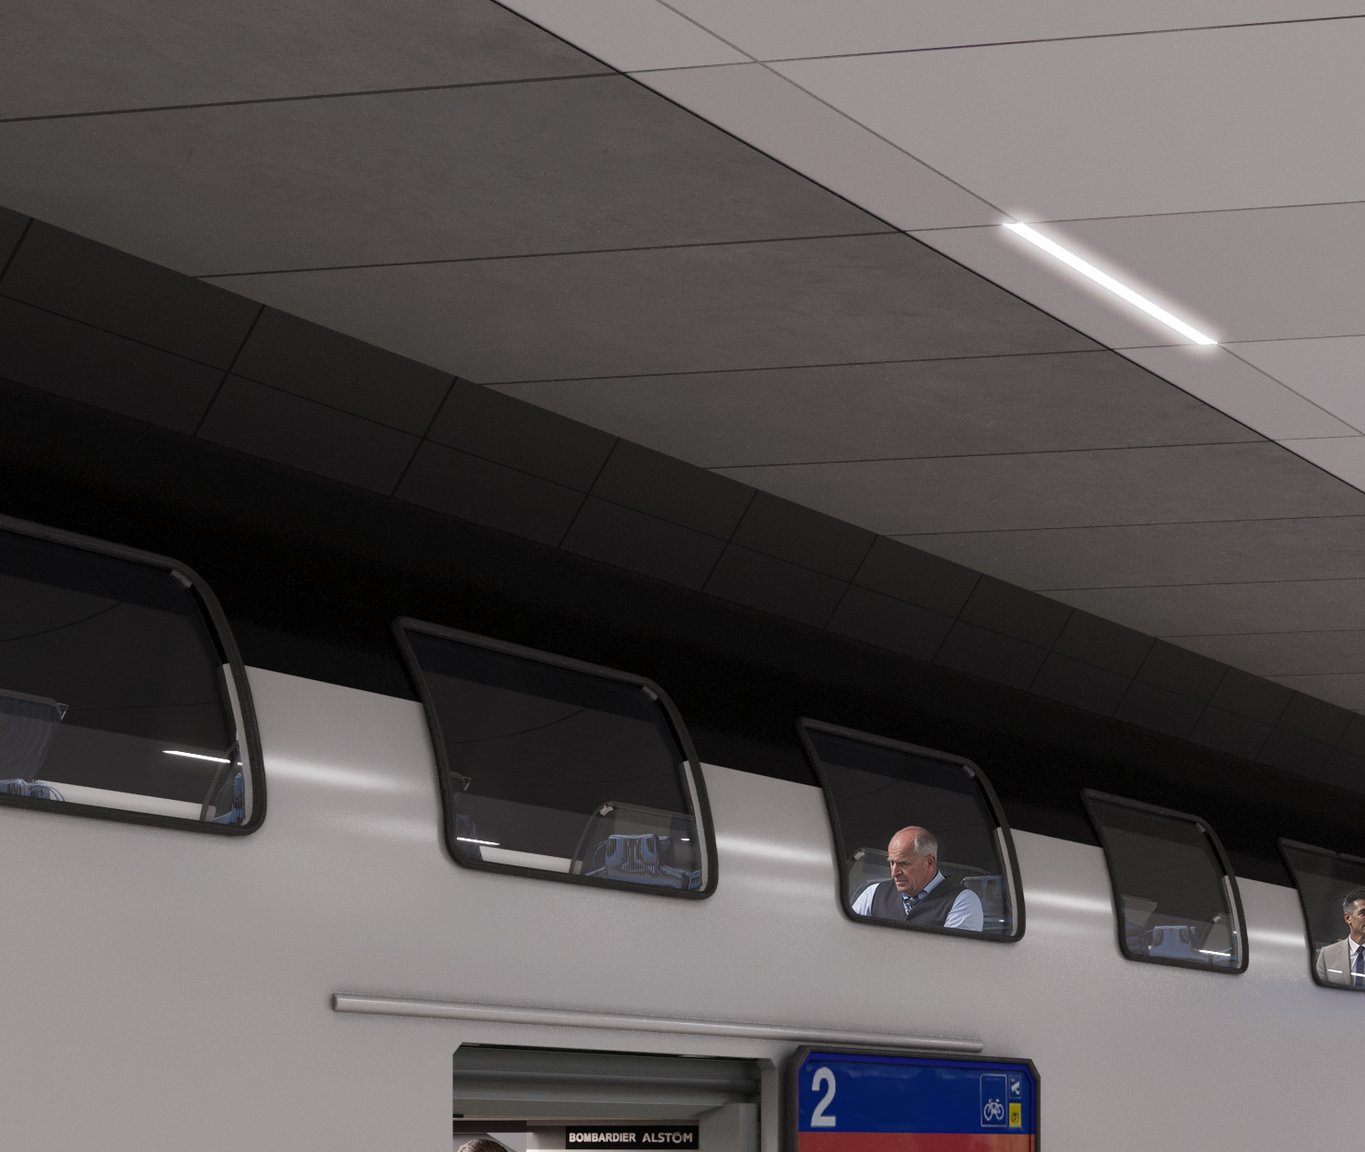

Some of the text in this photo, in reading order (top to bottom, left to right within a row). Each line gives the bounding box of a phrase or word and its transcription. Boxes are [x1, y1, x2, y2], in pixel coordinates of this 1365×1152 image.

[810, 1067, 836, 1127] 2
[569, 1131, 693, 1144] BOMBARDIER ALSTOM
